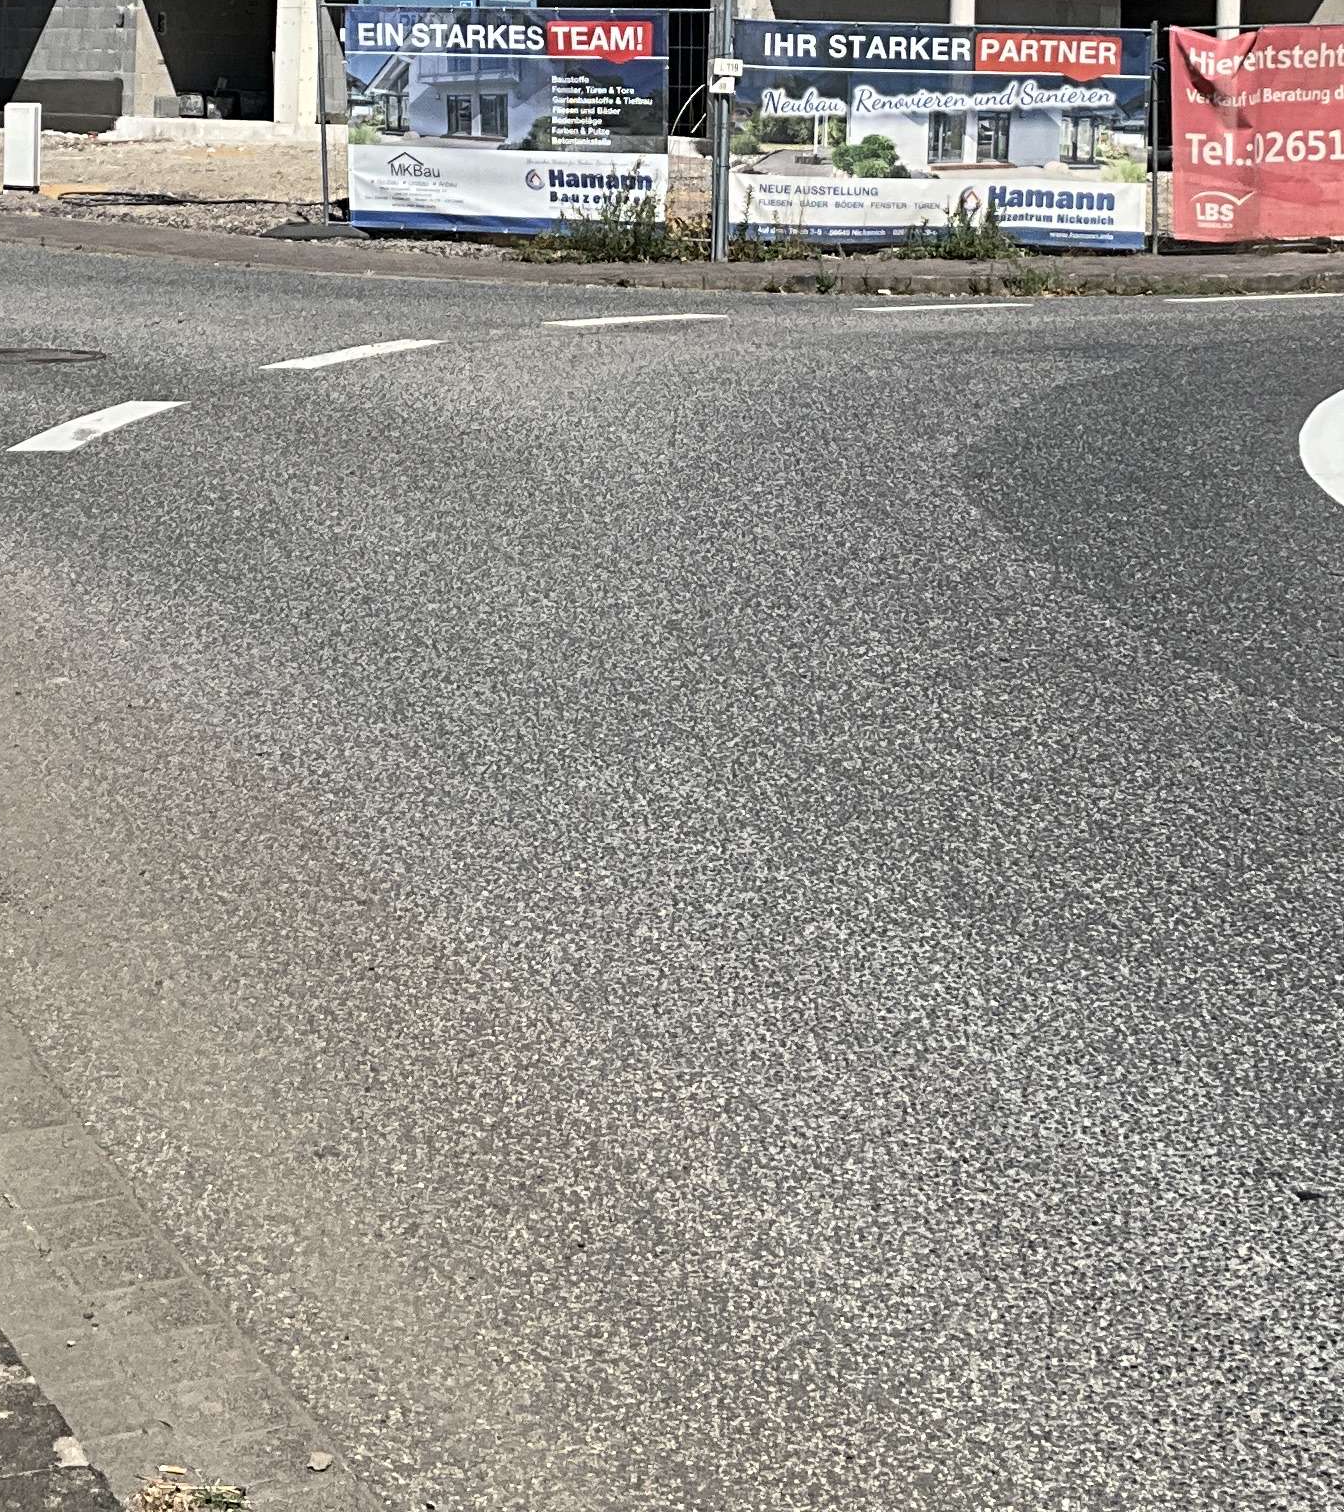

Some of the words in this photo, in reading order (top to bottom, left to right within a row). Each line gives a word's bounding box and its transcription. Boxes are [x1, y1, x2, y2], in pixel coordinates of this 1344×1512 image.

[357, 22, 404, 47] EIN
[411, 23, 545, 51] STARKES
[550, 26, 645, 51] TEAM!
[764, 32, 817, 58] IHR
[829, 33, 971, 62] STARKER
[980, 39, 1118, 66] PARTNER
[855, 88, 967, 112] Renovieren
[973, 84, 1014, 109] und
[1019, 81, 1113, 106] Sanieren
[1263, 87, 1330, 106] Beratung
[1184, 131, 1254, 166] Tel.:
[548, 168, 653, 191] Hamann
[758, 183, 792, 195] NEUE
[794, 184, 879, 197] AUSSTELLUNG
[758, 198, 793, 208] FLIESEN
[870, 200, 908, 210] FENSTER
[987, 185, 1116, 212] Hamann
[1194, 201, 1235, 222] LBS
